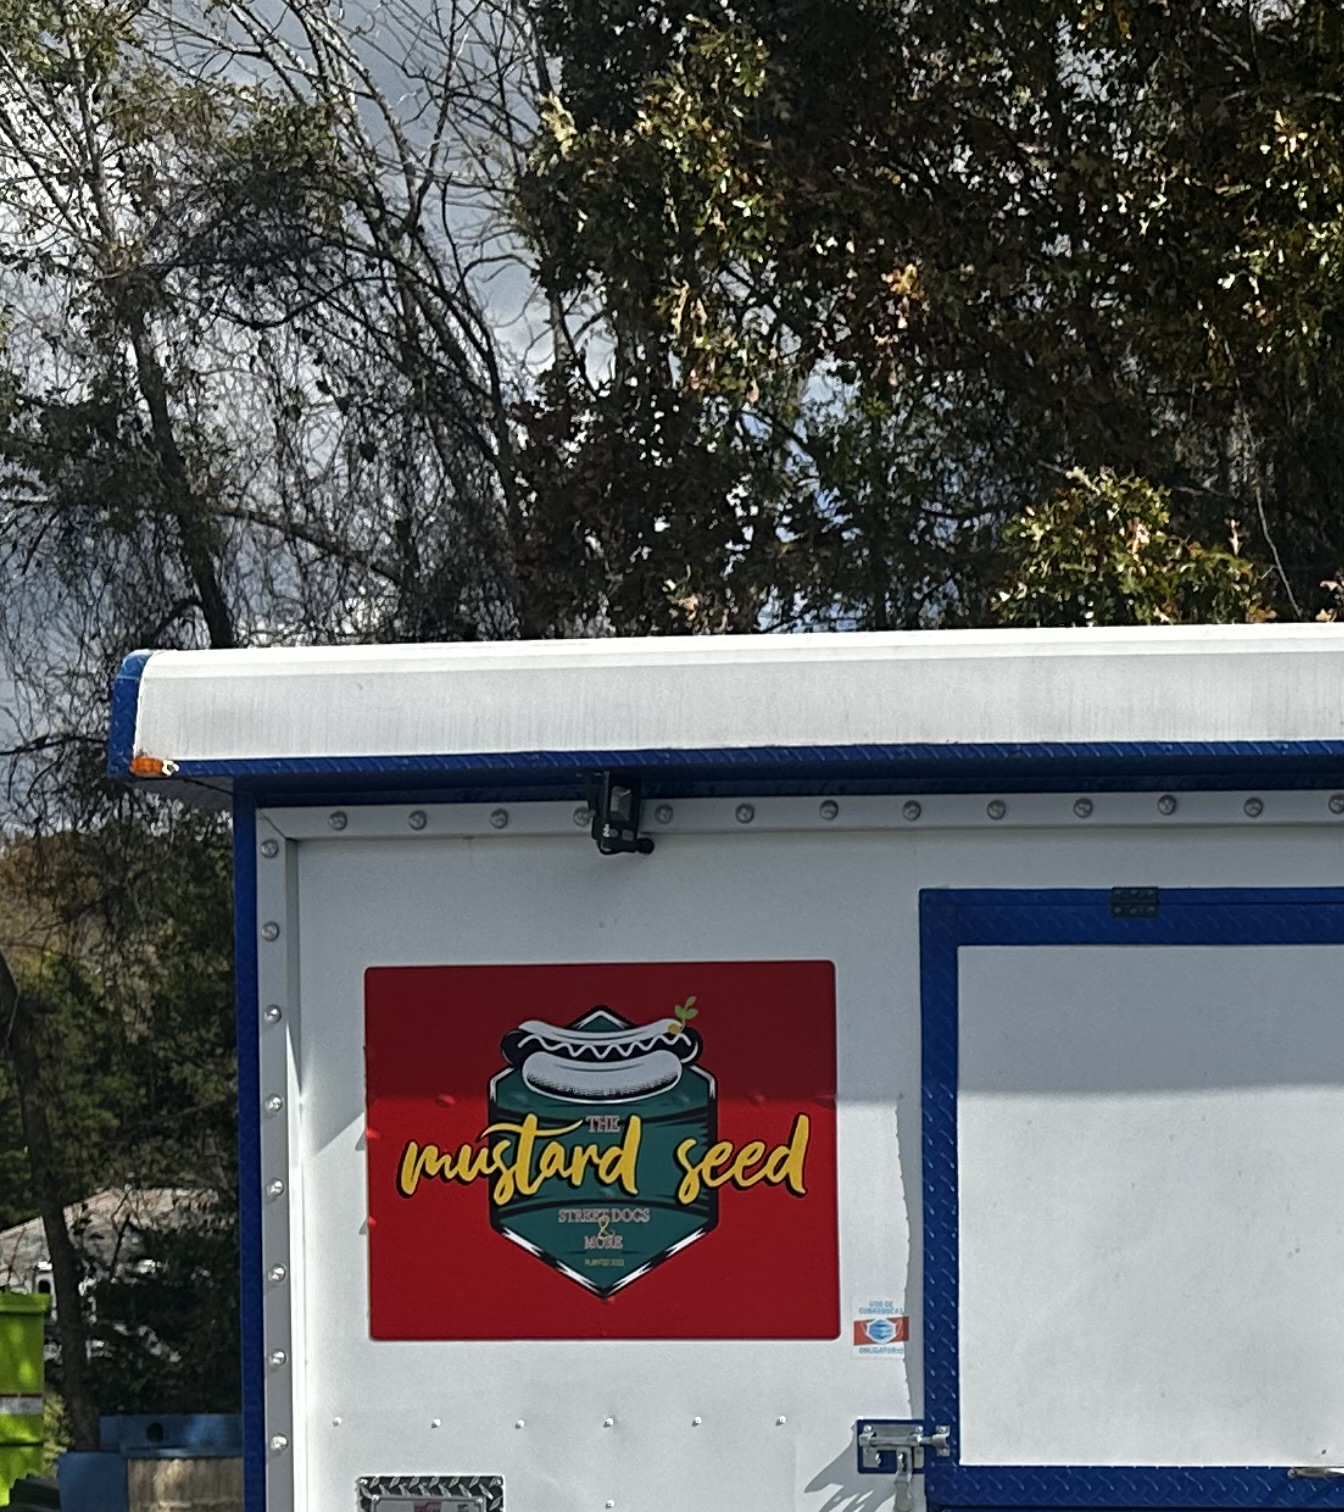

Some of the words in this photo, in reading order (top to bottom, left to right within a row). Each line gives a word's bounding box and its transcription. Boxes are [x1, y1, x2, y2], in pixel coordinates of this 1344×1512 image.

[585, 1115, 620, 1133] THE
[401, 1113, 641, 1206] mustard
[677, 1113, 810, 1204] seed
